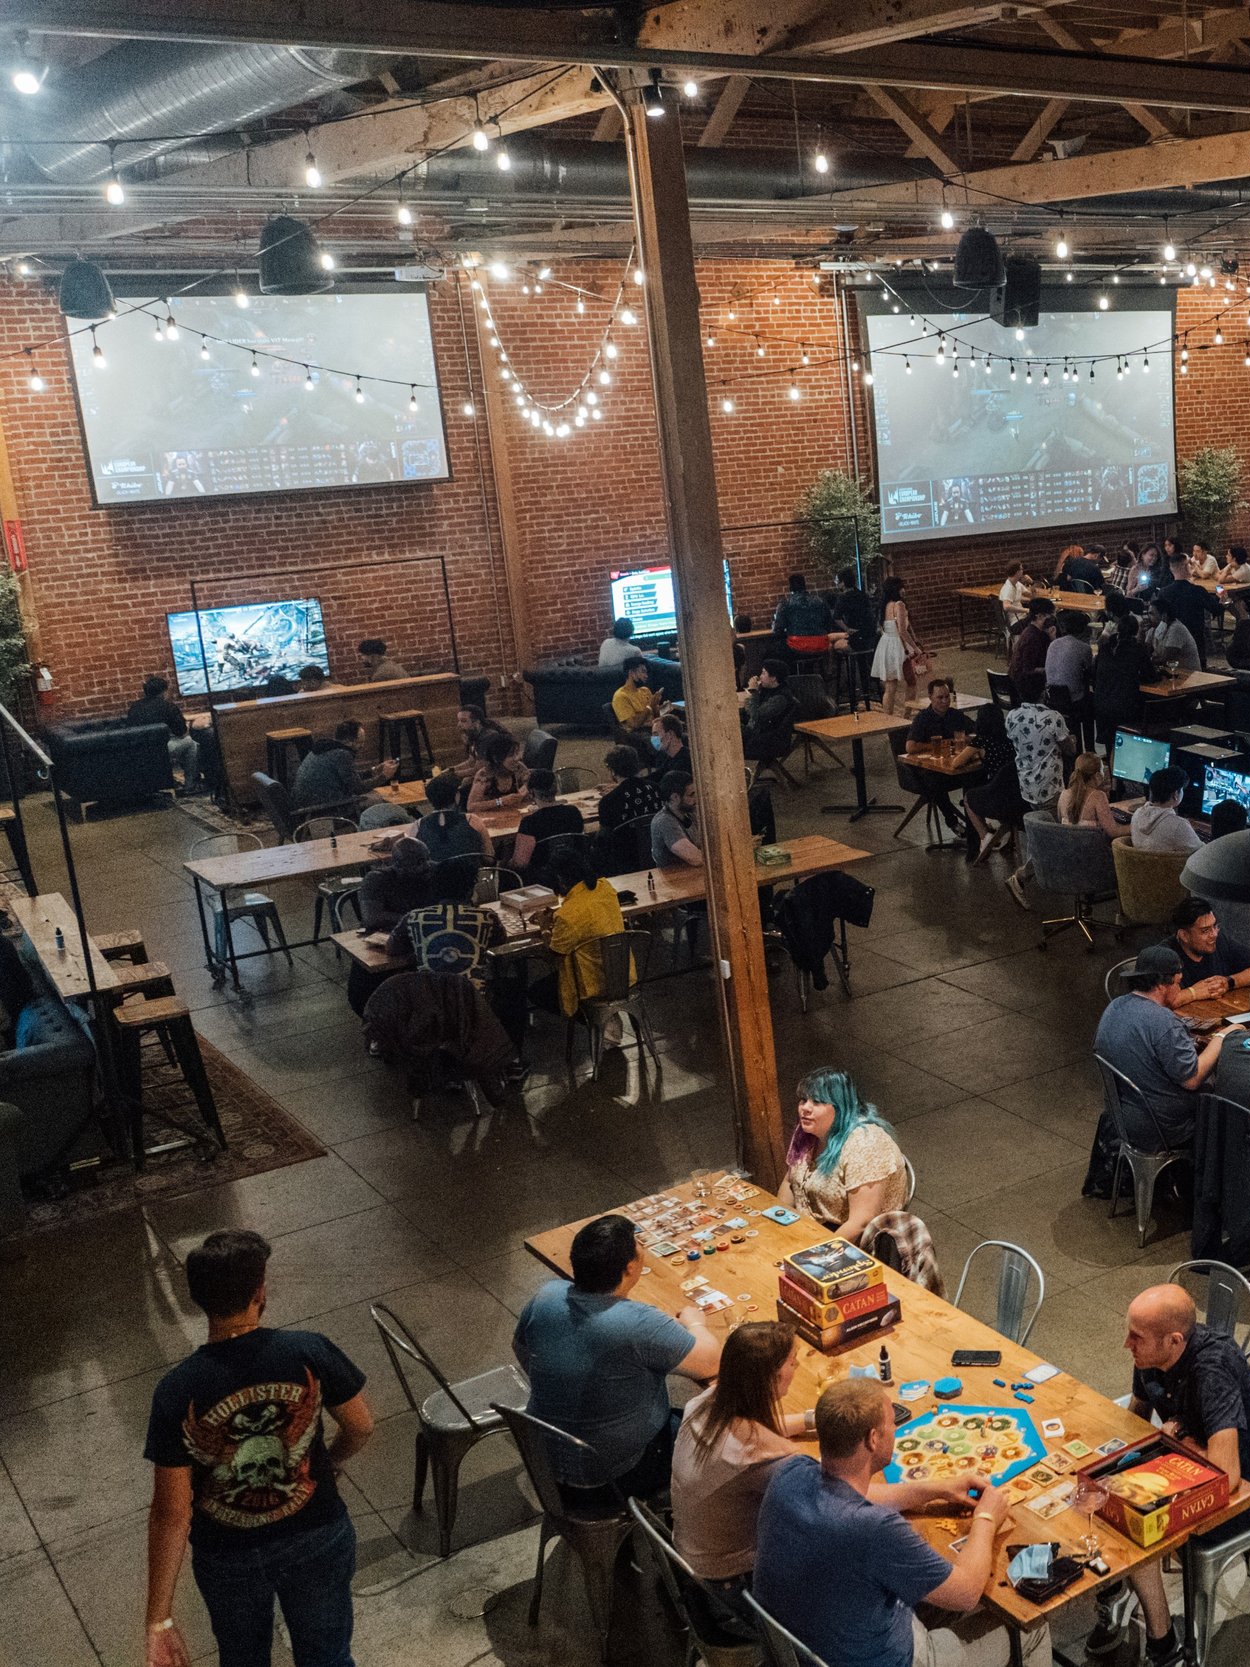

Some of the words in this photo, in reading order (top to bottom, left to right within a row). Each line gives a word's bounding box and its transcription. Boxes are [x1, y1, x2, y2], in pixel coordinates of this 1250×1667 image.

[842, 1293, 875, 1315] CATAN
[204, 1383, 304, 1427] HOLLISTER
[1167, 1457, 1204, 1476] CATAN
[1182, 1494, 1215, 1519] CATAN
